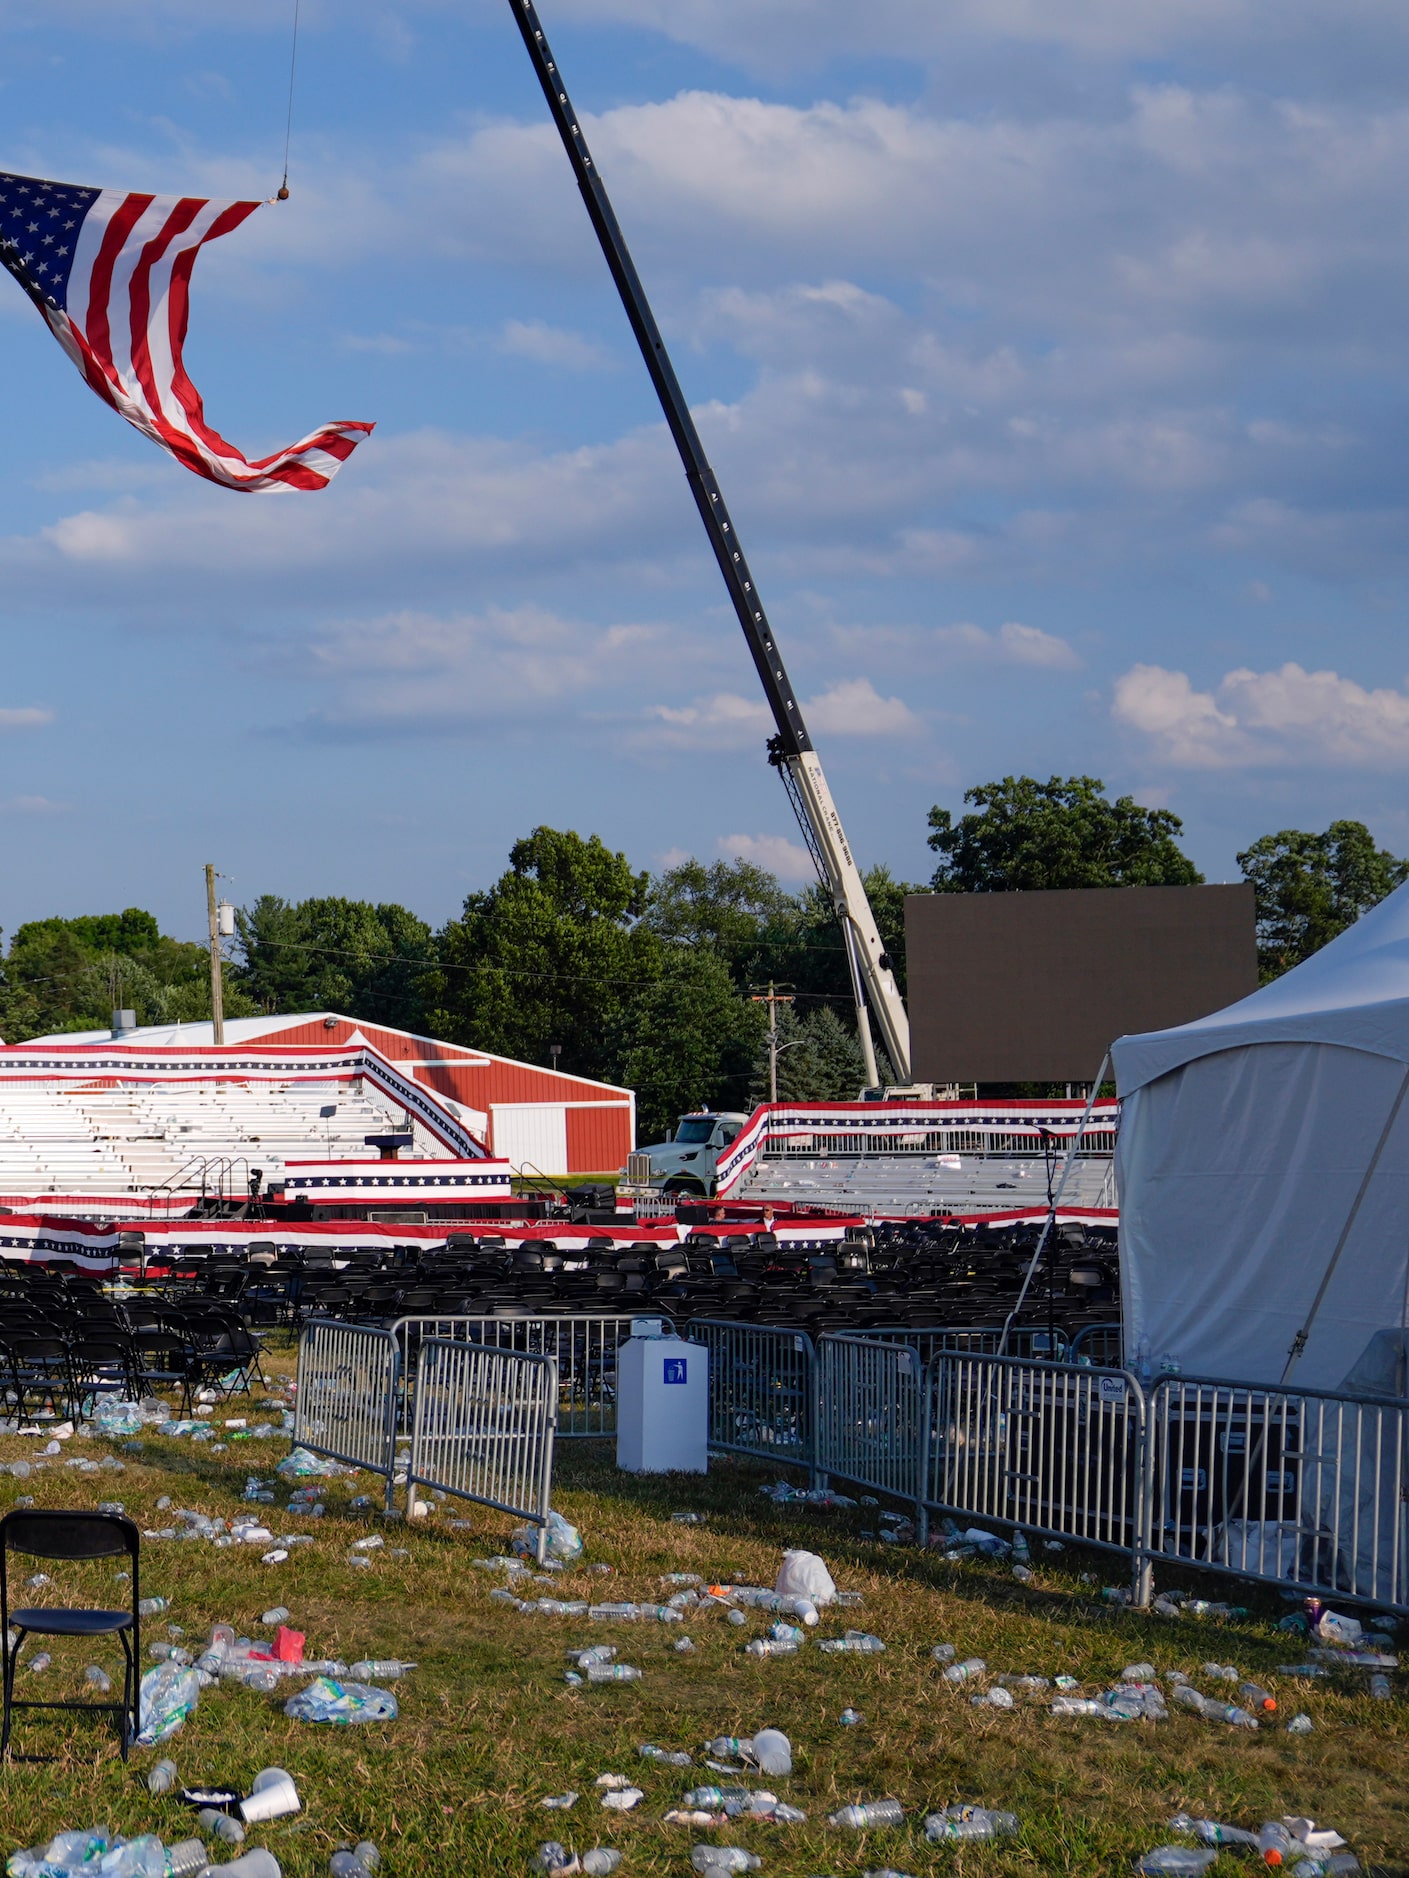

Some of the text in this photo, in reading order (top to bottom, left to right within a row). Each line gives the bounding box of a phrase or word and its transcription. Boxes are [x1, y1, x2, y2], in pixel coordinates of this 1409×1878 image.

[808, 766, 834, 833] NATIONAL CRANE
[1103, 1383, 1122, 1392] United
